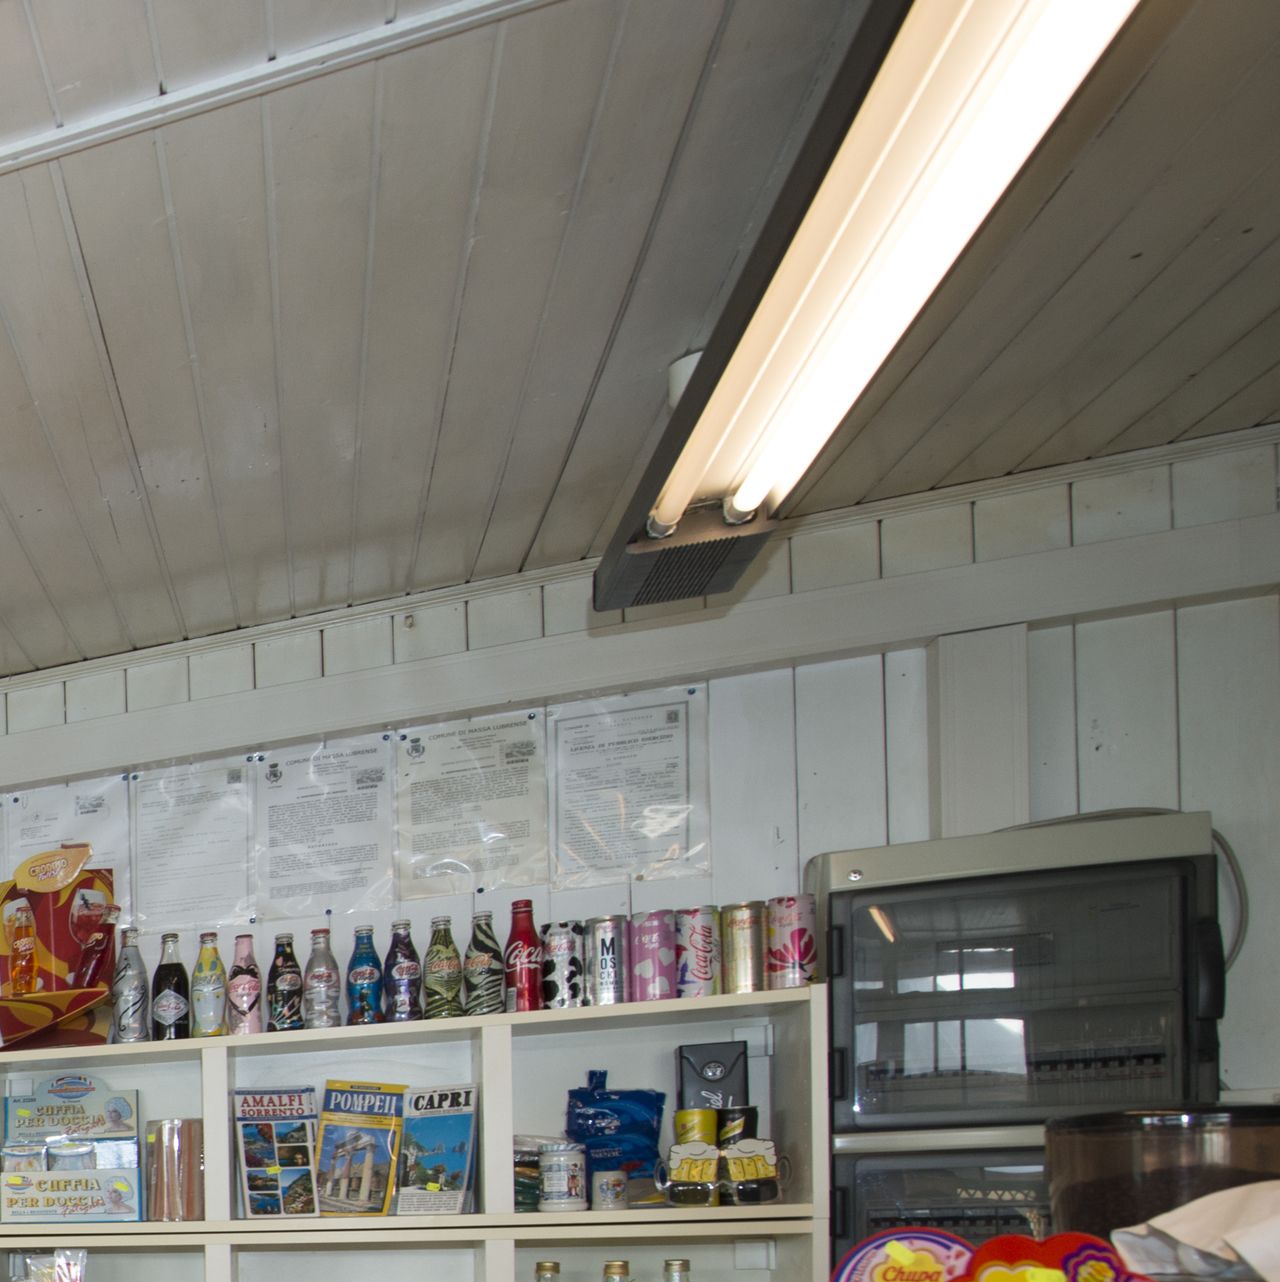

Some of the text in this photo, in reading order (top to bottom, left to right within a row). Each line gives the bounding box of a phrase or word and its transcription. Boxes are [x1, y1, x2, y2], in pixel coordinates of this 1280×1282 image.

[468, 726, 491, 735] MASSA
[493, 721, 527, 732] LUBRENSE
[345, 748, 378, 758] LUBRENSE
[241, 1094, 304, 1108] AMALFI
[330, 1091, 397, 1115] POMPEII
[414, 1090, 472, 1112] CAPRI
[37, 1104, 86, 1116] CUFFIA
[241, 1107, 304, 1116] SORRENTO
[16, 1118, 45, 1128] PER
[36, 1178, 100, 1192] CUFFIA
[7, 1197, 38, 1208] PER
